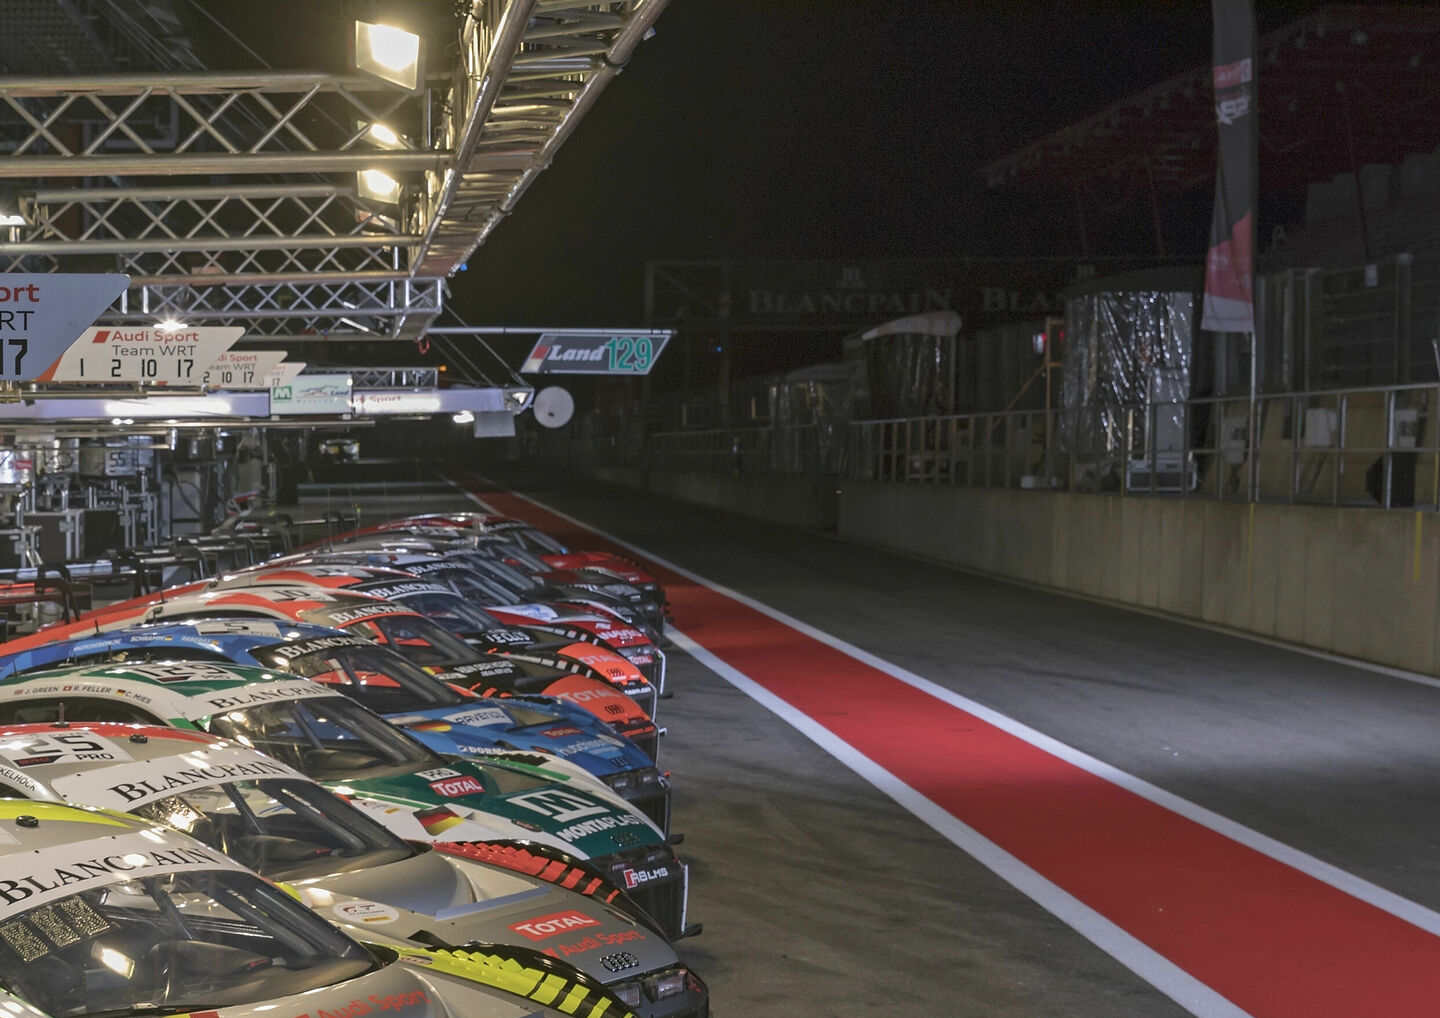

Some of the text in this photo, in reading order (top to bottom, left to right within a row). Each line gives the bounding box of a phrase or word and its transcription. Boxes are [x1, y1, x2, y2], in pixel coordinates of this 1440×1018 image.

[112, 330, 200, 345] Audi Sport
[112, 345, 197, 357] Team WRT
[230, 353, 258, 363] Sport
[548, 344, 605, 362] Land
[606, 337, 653, 371] 129
[79, 358, 194, 378] 1 2 10 17
[209, 363, 256, 371] eam WRT
[221, 371, 232, 383] 10
[244, 371, 254, 383] 17
[32, 686, 59, 694] GREEN
[81, 685, 112, 694] FELLER
[209, 684, 335, 709] BLANCPAIN
[75, 753, 114, 761] PRO
[108, 759, 290, 803] BLANCPAIN
[432, 780, 483, 797] TOTAL
[556, 813, 646, 843] MONTAPLAST
[516, 915, 595, 936] TOTAL
[559, 929, 647, 957] Audi Sport
[368, 989, 432, 1018] Sport
